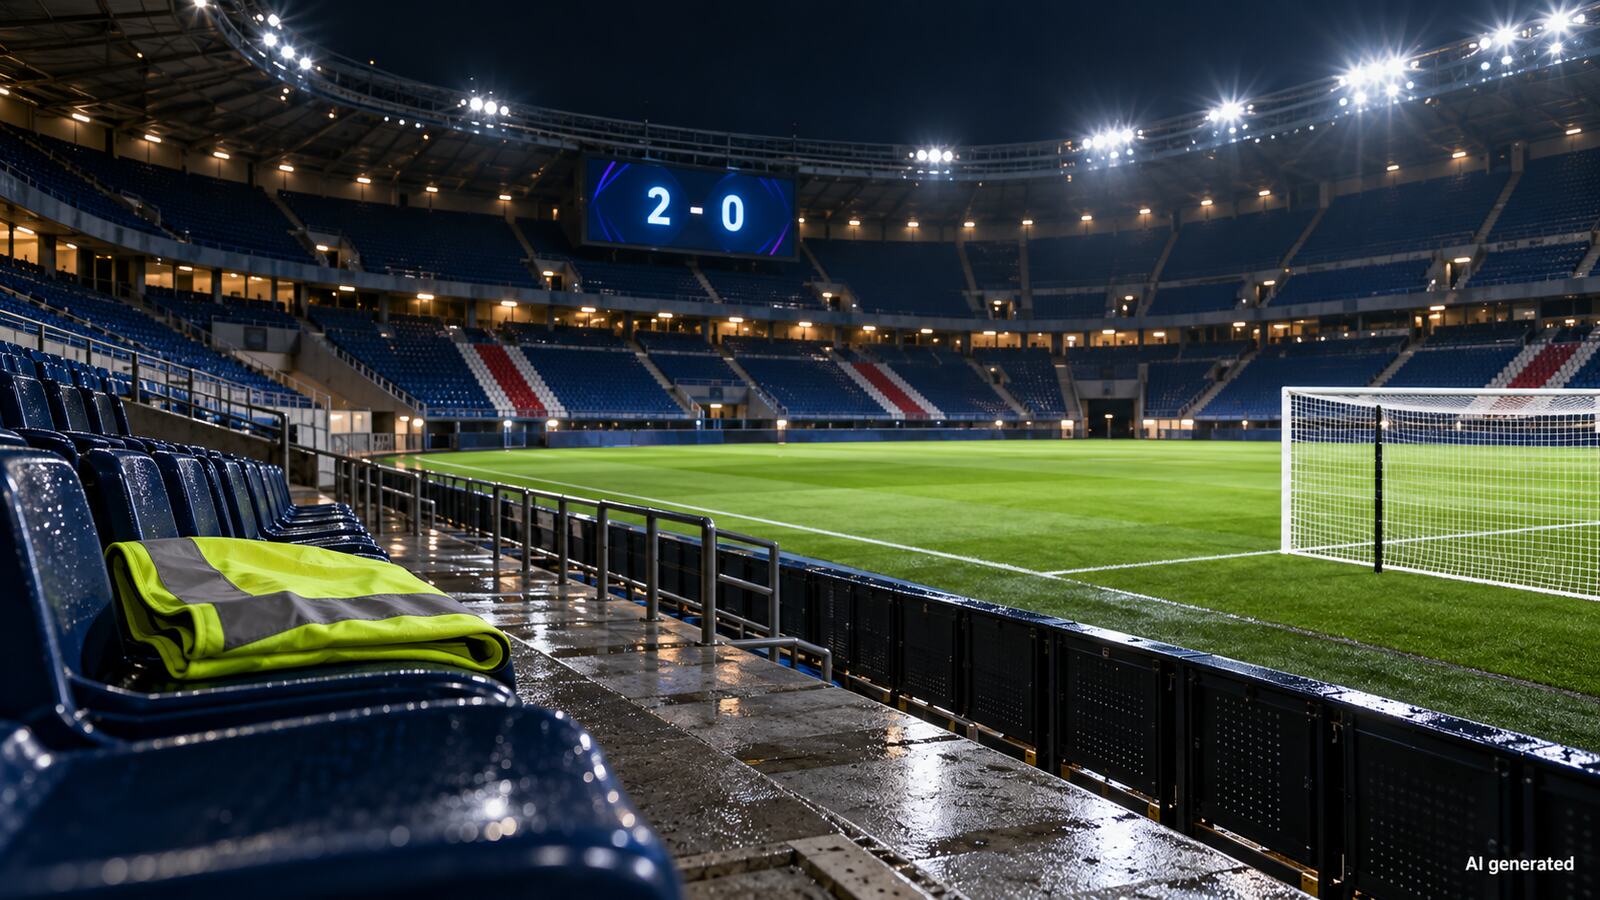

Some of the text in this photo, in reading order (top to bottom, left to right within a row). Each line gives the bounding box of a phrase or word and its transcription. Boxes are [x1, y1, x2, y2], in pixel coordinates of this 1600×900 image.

[647, 186, 744, 232] 2 - 0
